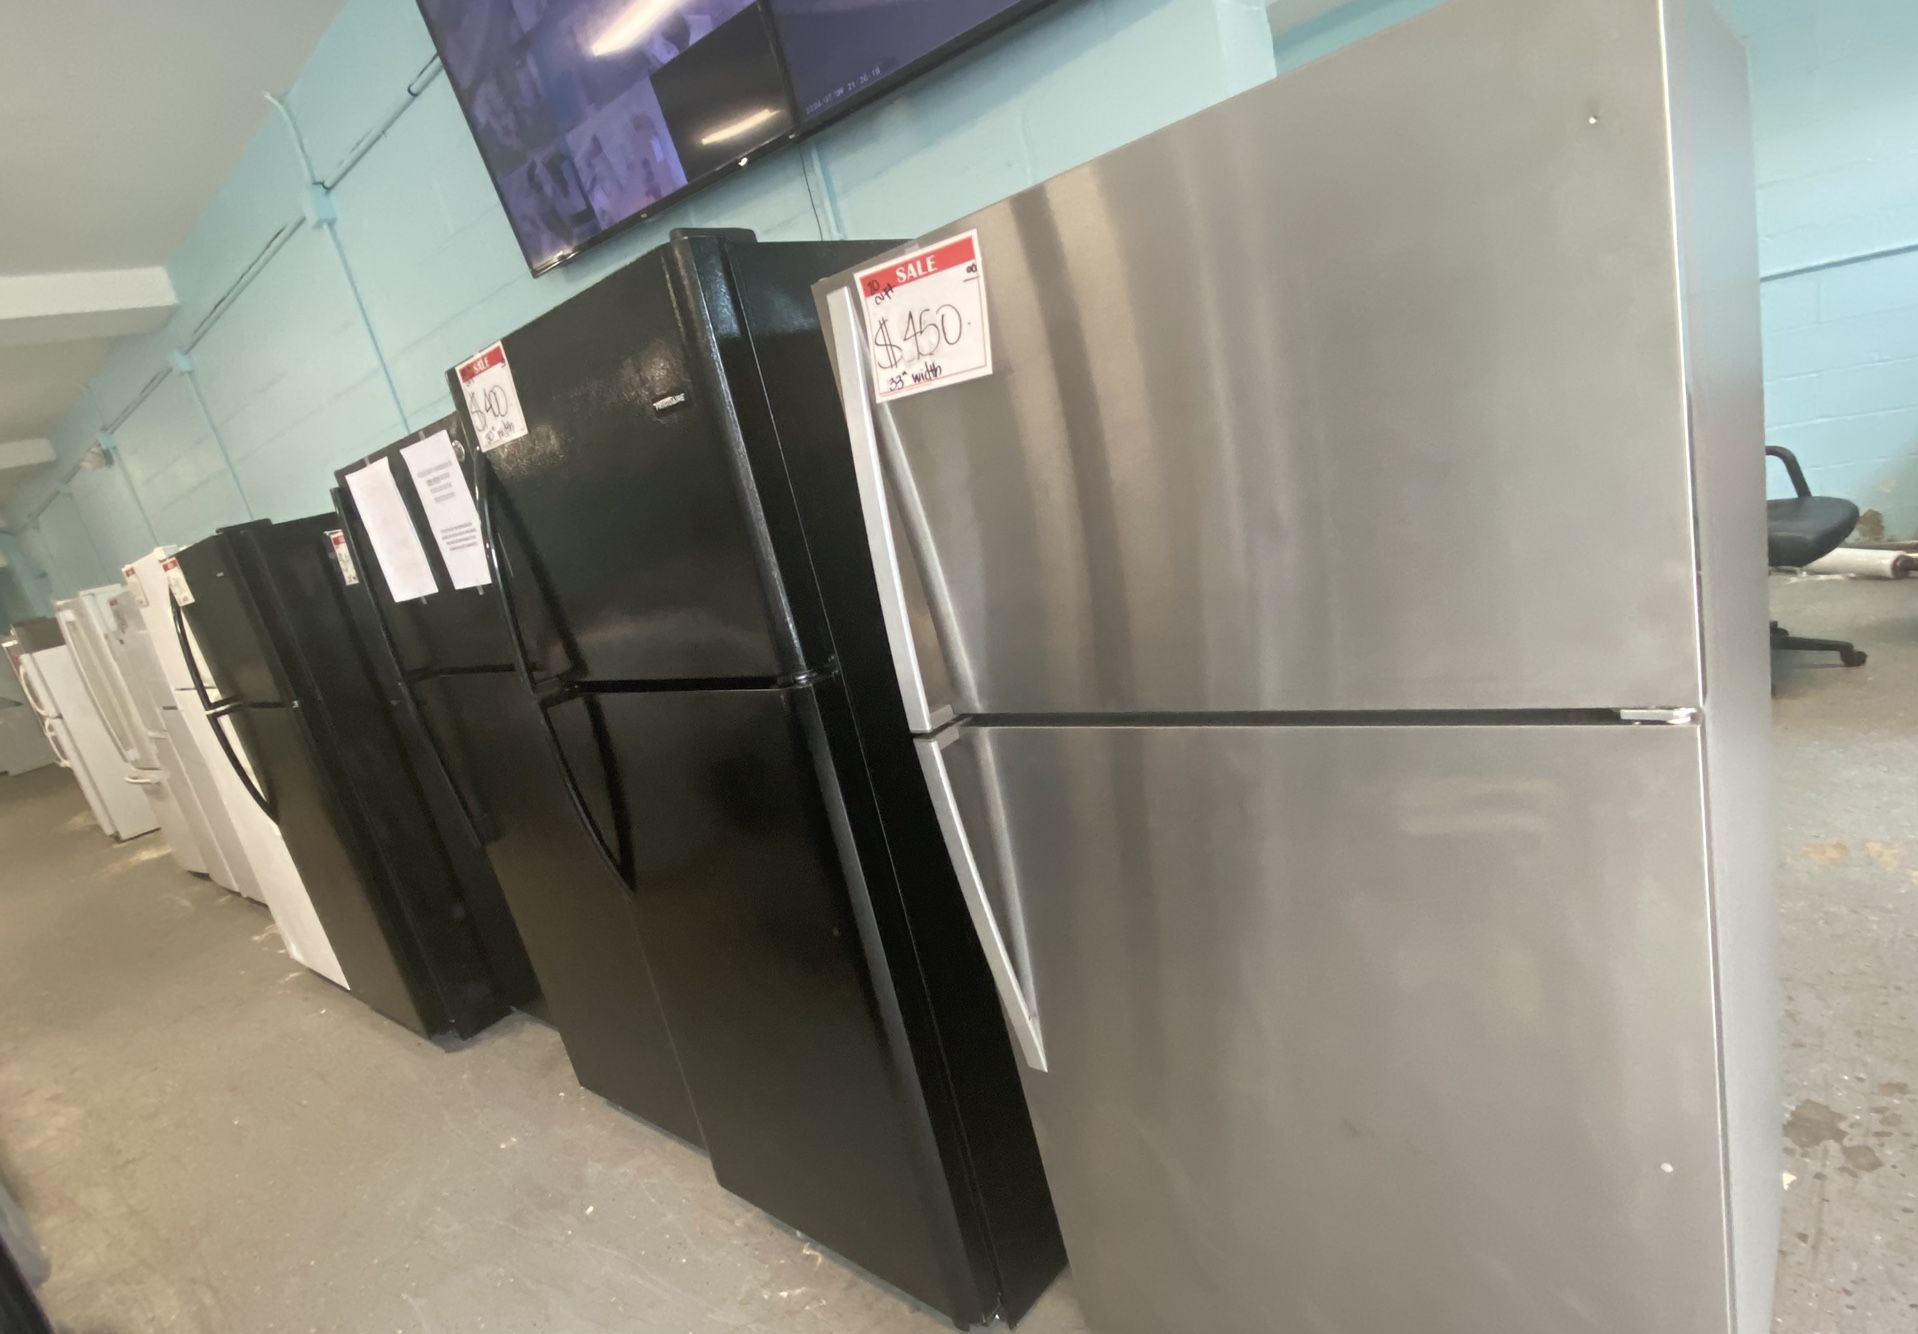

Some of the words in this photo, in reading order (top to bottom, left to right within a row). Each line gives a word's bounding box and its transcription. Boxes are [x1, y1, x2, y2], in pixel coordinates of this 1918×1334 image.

[895, 255, 939, 283] SALE
[874, 303, 963, 369] $450
[472, 356, 491, 374] SALE
[912, 361, 942, 384] width
